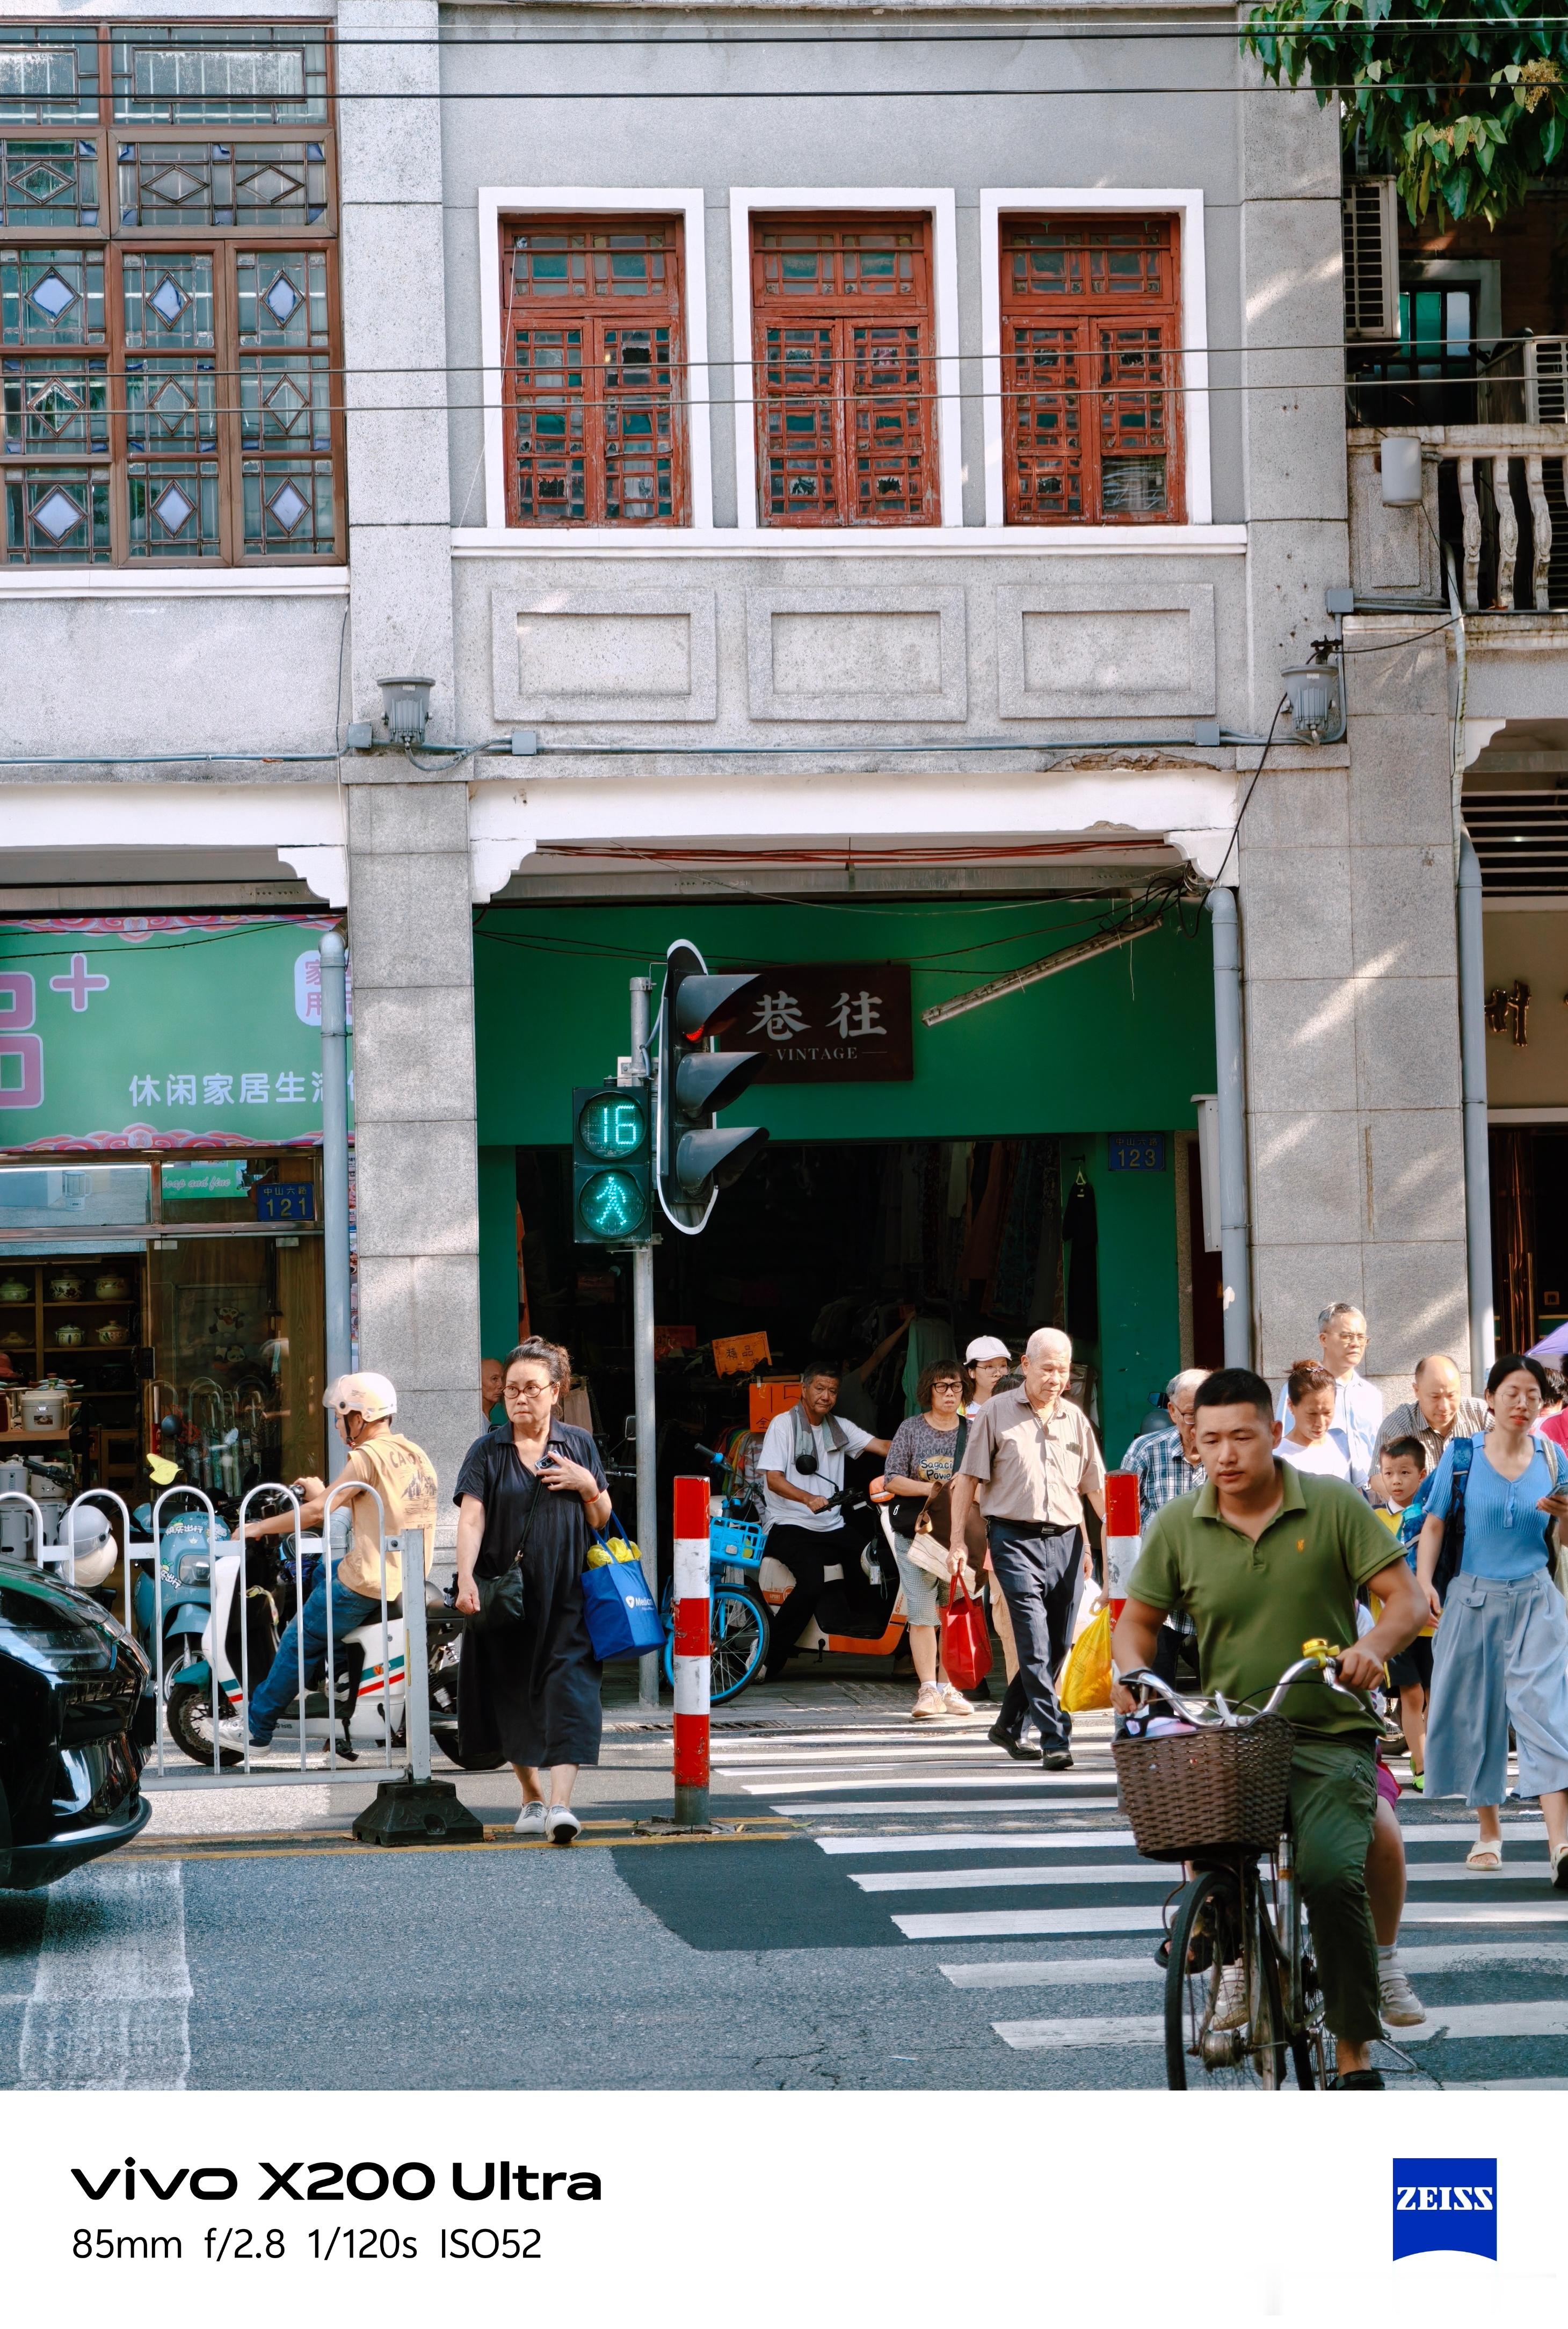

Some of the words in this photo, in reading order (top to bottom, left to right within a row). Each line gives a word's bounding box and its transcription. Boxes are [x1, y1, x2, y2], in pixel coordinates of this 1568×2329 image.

[746, 990, 887, 1040] 巷往
[777, 1047, 857, 1061] VINTAGE
[129, 1071, 354, 1107] 休闲家居生
[604, 1105, 636, 1145] 16
[1116, 1138, 1158, 1146] 中山六路
[1118, 1149, 1156, 1167] 123
[188, 1176, 209, 1188] and
[209, 1176, 231, 1190] fine
[264, 1186, 307, 1195] 中山六路
[266, 1198, 306, 1217] 121
[726, 1345, 753, 1359] 精品
[165, 1524, 204, 1536] 快乐出行
